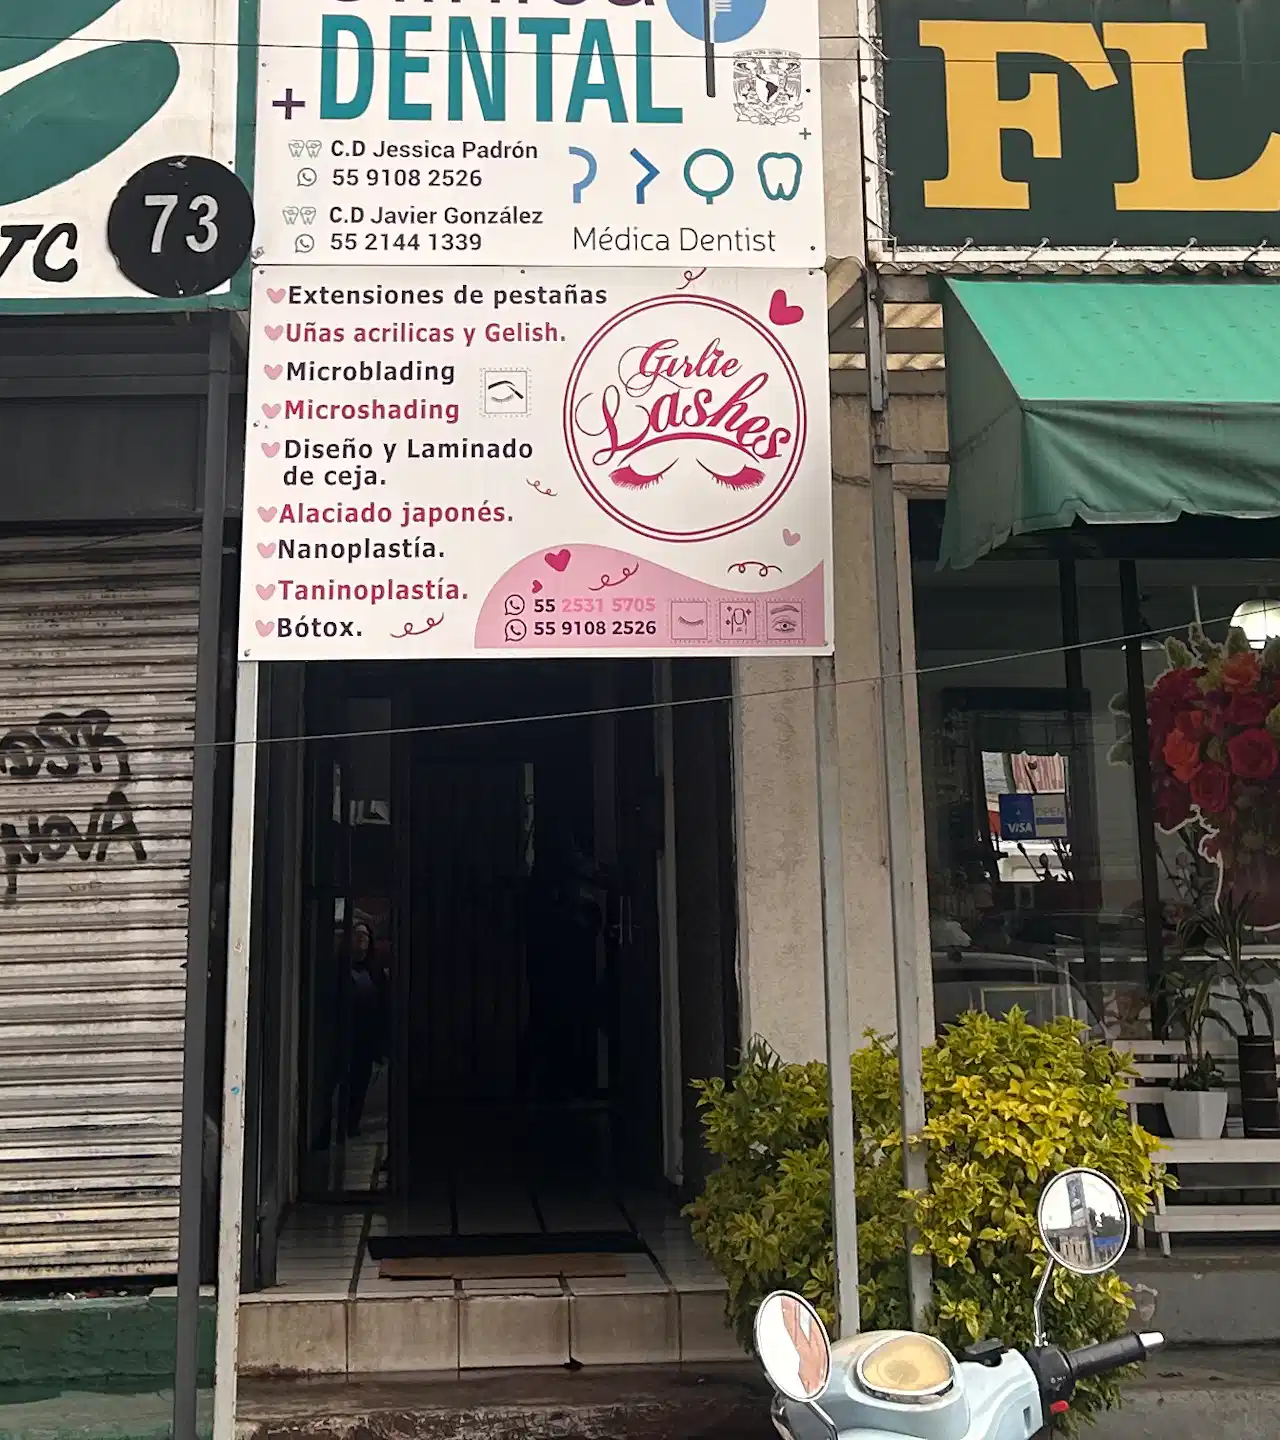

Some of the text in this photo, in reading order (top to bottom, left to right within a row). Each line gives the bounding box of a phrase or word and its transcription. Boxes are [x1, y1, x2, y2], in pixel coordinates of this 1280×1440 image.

[320, 14, 683, 124] DENTAL
[372, 139, 455, 159] Jessica
[462, 139, 538, 159] Padrón
[332, 168, 482, 187] 55 9108 2526
[143, 193, 220, 254] 73
[370, 205, 438, 225] Javier
[444, 205, 543, 225] González
[330, 233, 482, 251] 55 2144 1339
[573, 226, 776, 252] Médica Dentist
[288, 283, 607, 310] Extensiones de pestañas
[286, 321, 566, 348] Uñas acrilicas y Gelish.
[286, 360, 455, 386] Microblading
[285, 398, 459, 425] Microshading
[575, 372, 791, 466] Lashes
[284, 437, 533, 464] Diseño y Laminado
[283, 465, 386, 491] de ceja.
[279, 499, 513, 528] Alaciado japonés.
[278, 535, 444, 564] Nanoplastía.
[277, 577, 468, 606] Taninoplastía.
[533, 597, 656, 613] 55 2531 5705
[277, 614, 362, 638] Bótox.
[533, 620, 657, 636] 55 9108 2526
[1007, 822, 1034, 834] VISA
